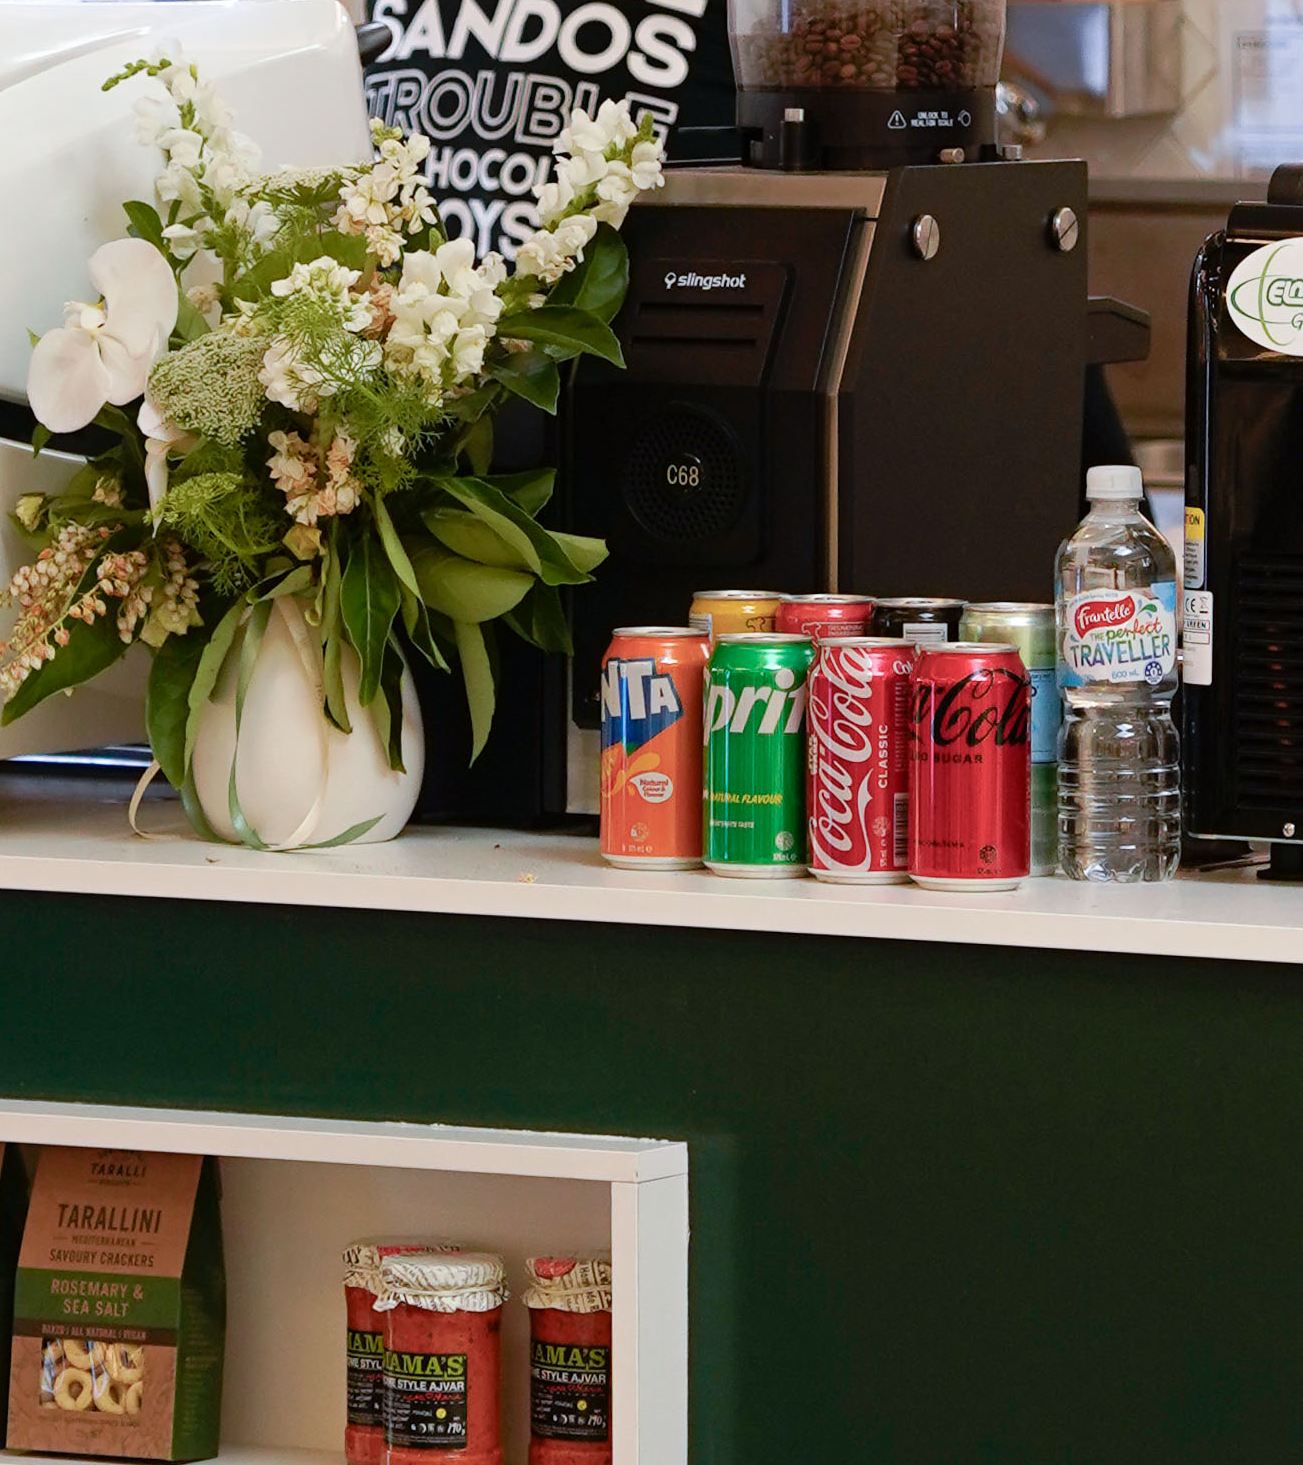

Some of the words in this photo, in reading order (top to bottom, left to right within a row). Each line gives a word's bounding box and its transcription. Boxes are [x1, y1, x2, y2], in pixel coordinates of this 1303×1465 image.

[676, 272, 746, 291] slingshot
[666, 464, 700, 487] C68
[1078, 603, 1132, 631] frantelle
[1105, 617, 1163, 645] perfect
[1070, 634, 1171, 669] TRAVELLER
[877, 724, 889, 789] CLASSIC
[57, 1203, 163, 1235] TARALLINI
[49, 1248, 99, 1264] SAVOURY
[99, 1251, 155, 1268] CRACKERS
[50, 1278, 129, 1299] ROSEMARY
[132, 1283, 145, 1300] &
[63, 1298, 90, 1315] SEA
[96, 1301, 130, 1318] SALT
[397, 1380, 428, 1391] STYLE
[429, 1381, 465, 1393] AJVAR
[541, 1368, 569, 1383] STYLE
[570, 1370, 607, 1385] AJVAR
